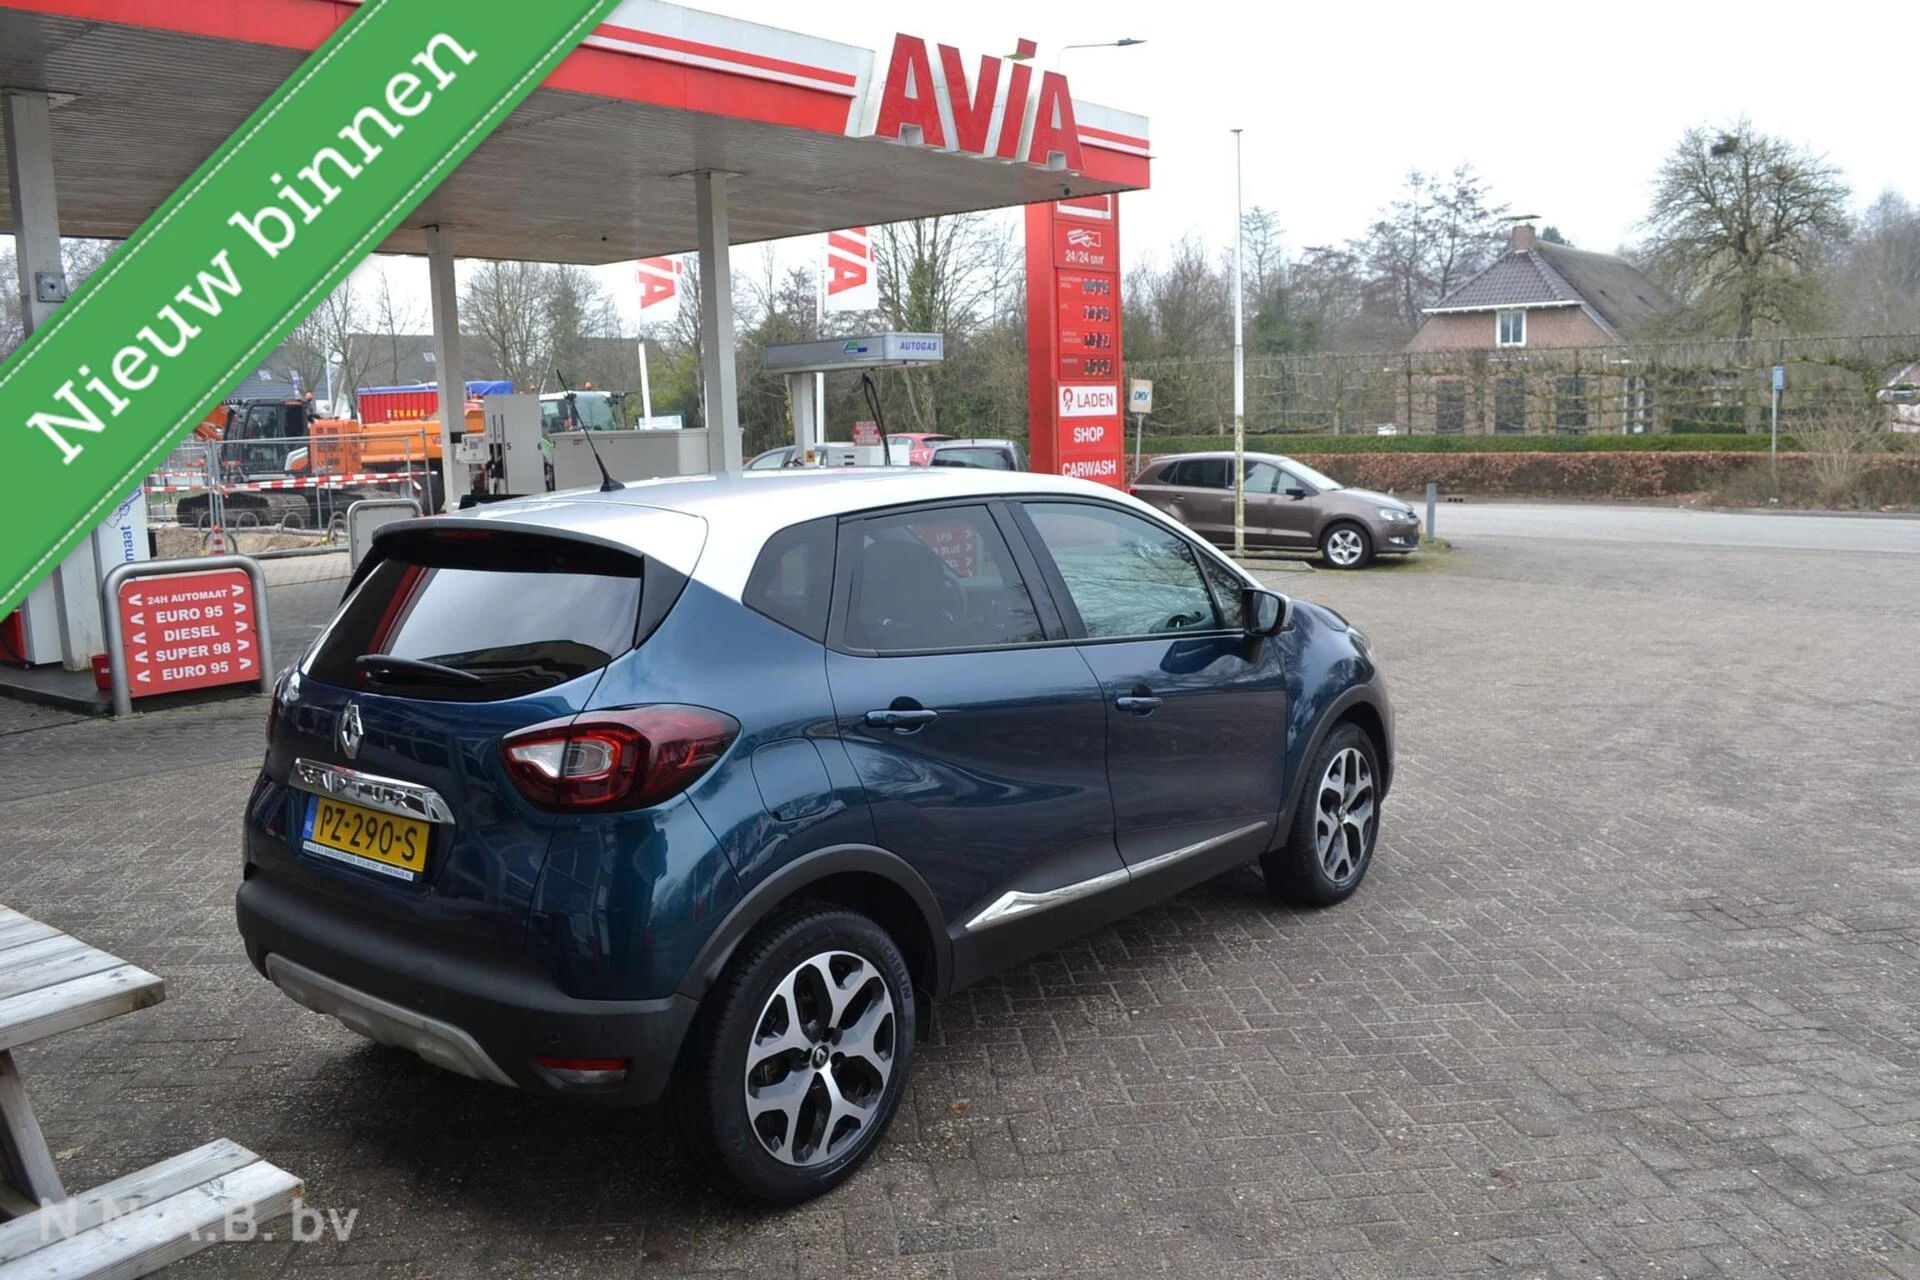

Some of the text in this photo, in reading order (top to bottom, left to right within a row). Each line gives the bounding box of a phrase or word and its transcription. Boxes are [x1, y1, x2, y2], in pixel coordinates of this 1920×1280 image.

[1065, 249, 1089, 263] 24/24
[900, 341, 937, 351] AUTOGAS
[1077, 393, 1113, 408] LADEN
[1073, 426, 1105, 443] SHOP
[1062, 460, 1117, 477] CARWASH
[147, 589, 228, 605] 24H AUTOMAAT
[156, 605, 223, 623] EURO 95
[164, 625, 220, 642] DIESEL
[156, 642, 231, 662] SUPER 98
[162, 661, 229, 681] EURO 95
[320, 804, 417, 862] PZ-290-S
